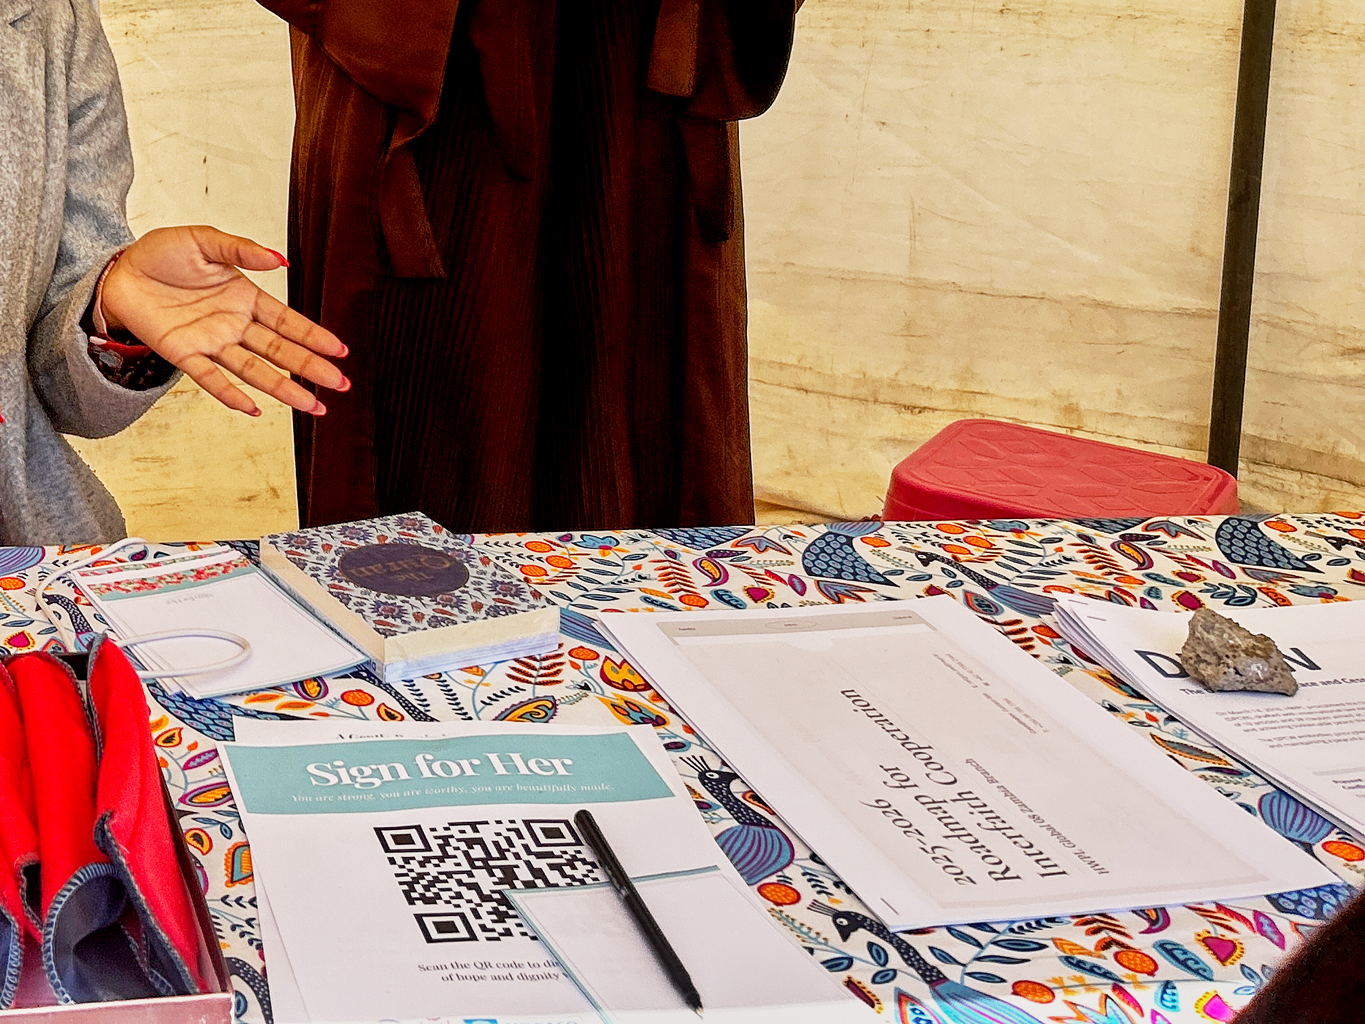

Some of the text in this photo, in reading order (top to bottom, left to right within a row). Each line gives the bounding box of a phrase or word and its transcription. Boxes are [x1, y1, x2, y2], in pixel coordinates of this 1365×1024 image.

[306, 752, 574, 790] Sign for Her
[839, 688, 958, 786] Cooperation
[291, 793, 313, 803] You
[315, 794, 334, 802] are
[379, 791, 400, 800] you
[403, 789, 422, 797] are
[424, 786, 468, 795] worthy,
[470, 785, 492, 794] you
[495, 784, 513, 792] are
[516, 782, 577, 793] beautifully
[581, 782, 614, 792] made.
[878, 763, 1024, 882] Roadmap for
[949, 789, 1069, 879] Interfaith
[964, 756, 1109, 876] HWPL Global 08 Zambia Branch
[858, 797, 977, 886] 2025-2026
[418, 962, 449, 972] Scan
[450, 960, 471, 970] the
[473, 960, 494, 971] QR
[495, 960, 525, 969] code
[527, 959, 541, 969] to
[441, 972, 454, 982] of
[457, 972, 487, 982] hope
[490, 972, 515, 981] and
[517, 971, 560, 982] dignity
